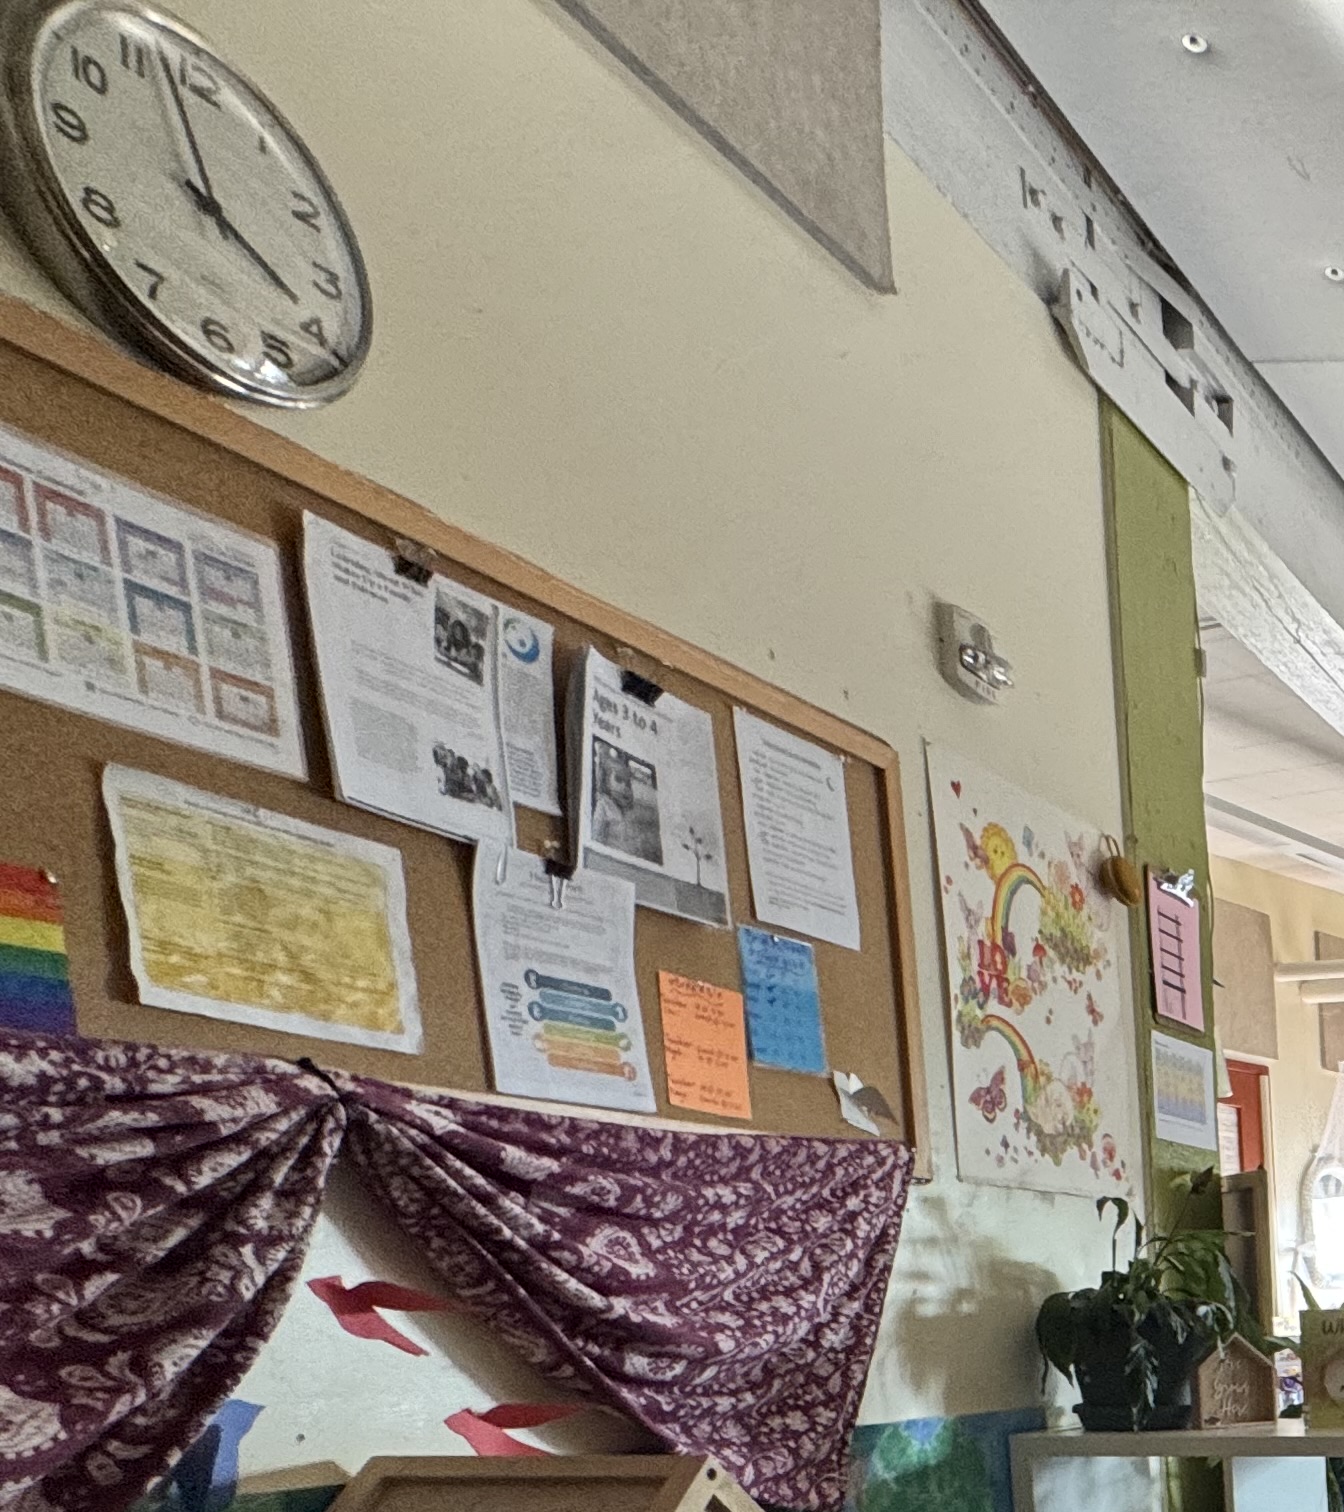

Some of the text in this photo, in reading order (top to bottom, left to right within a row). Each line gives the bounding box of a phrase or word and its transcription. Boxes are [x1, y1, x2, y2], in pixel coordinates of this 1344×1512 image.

[70, 45, 109, 95] 10
[119, 32, 147, 80] 11
[178, 53, 223, 112] 12
[50, 101, 89, 146] 9
[79, 185, 122, 229] 8
[291, 190, 322, 234] 2
[134, 259, 165, 301] 7
[312, 260, 343, 301] 3
[200, 316, 235, 355] 6
[259, 329, 294, 370] 5
[300, 315, 331, 350] 4
[632, 710, 647, 730] to
[650, 719, 659, 735] 4
